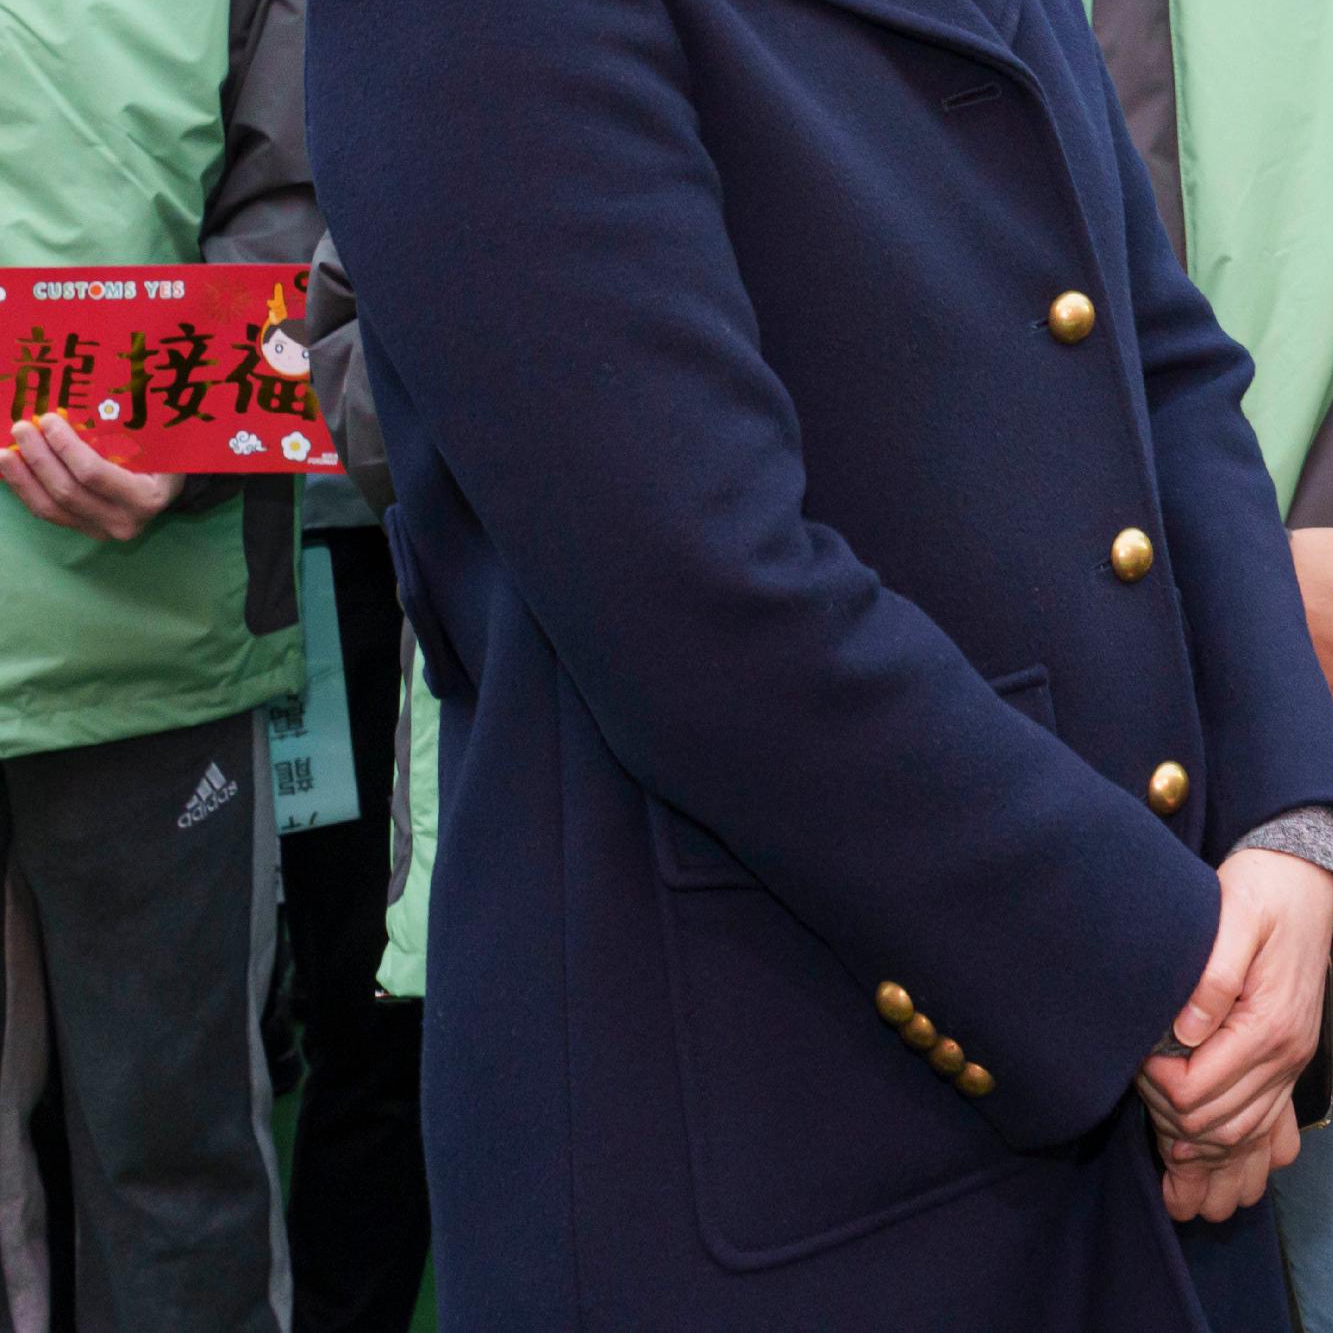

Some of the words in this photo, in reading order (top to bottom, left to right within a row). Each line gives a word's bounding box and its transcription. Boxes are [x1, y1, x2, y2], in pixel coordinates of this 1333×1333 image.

[33, 280, 137, 300] CUSTOMS
[144, 280, 186, 300] YES
[0, 322, 318, 429] 龍接福
[177, 780, 238, 828] adidas
